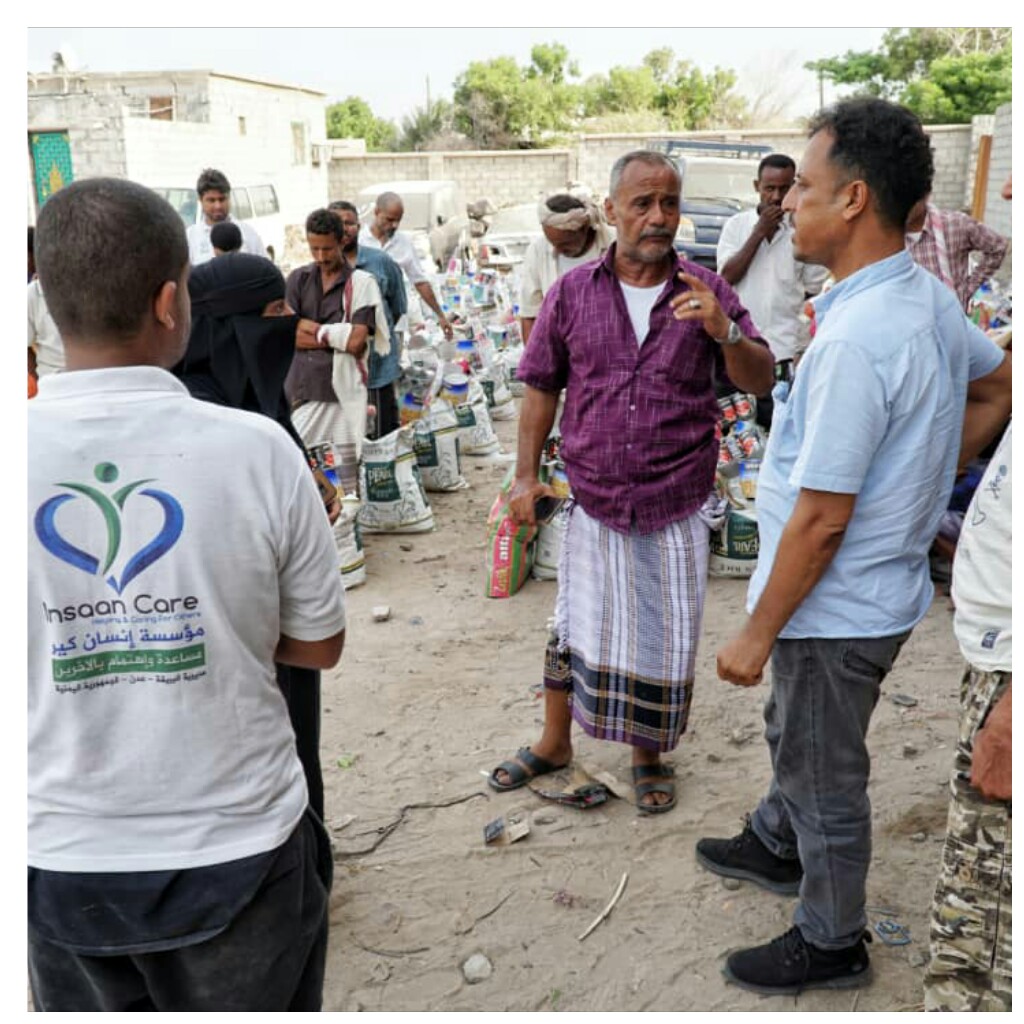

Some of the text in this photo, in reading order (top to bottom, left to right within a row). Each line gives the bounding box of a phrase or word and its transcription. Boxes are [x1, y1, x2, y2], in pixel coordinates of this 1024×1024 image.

[43, 594, 199, 624] Insaan Care
[83, 629, 136, 651] إنسان
[139, 623, 206, 642] مؤسسة
